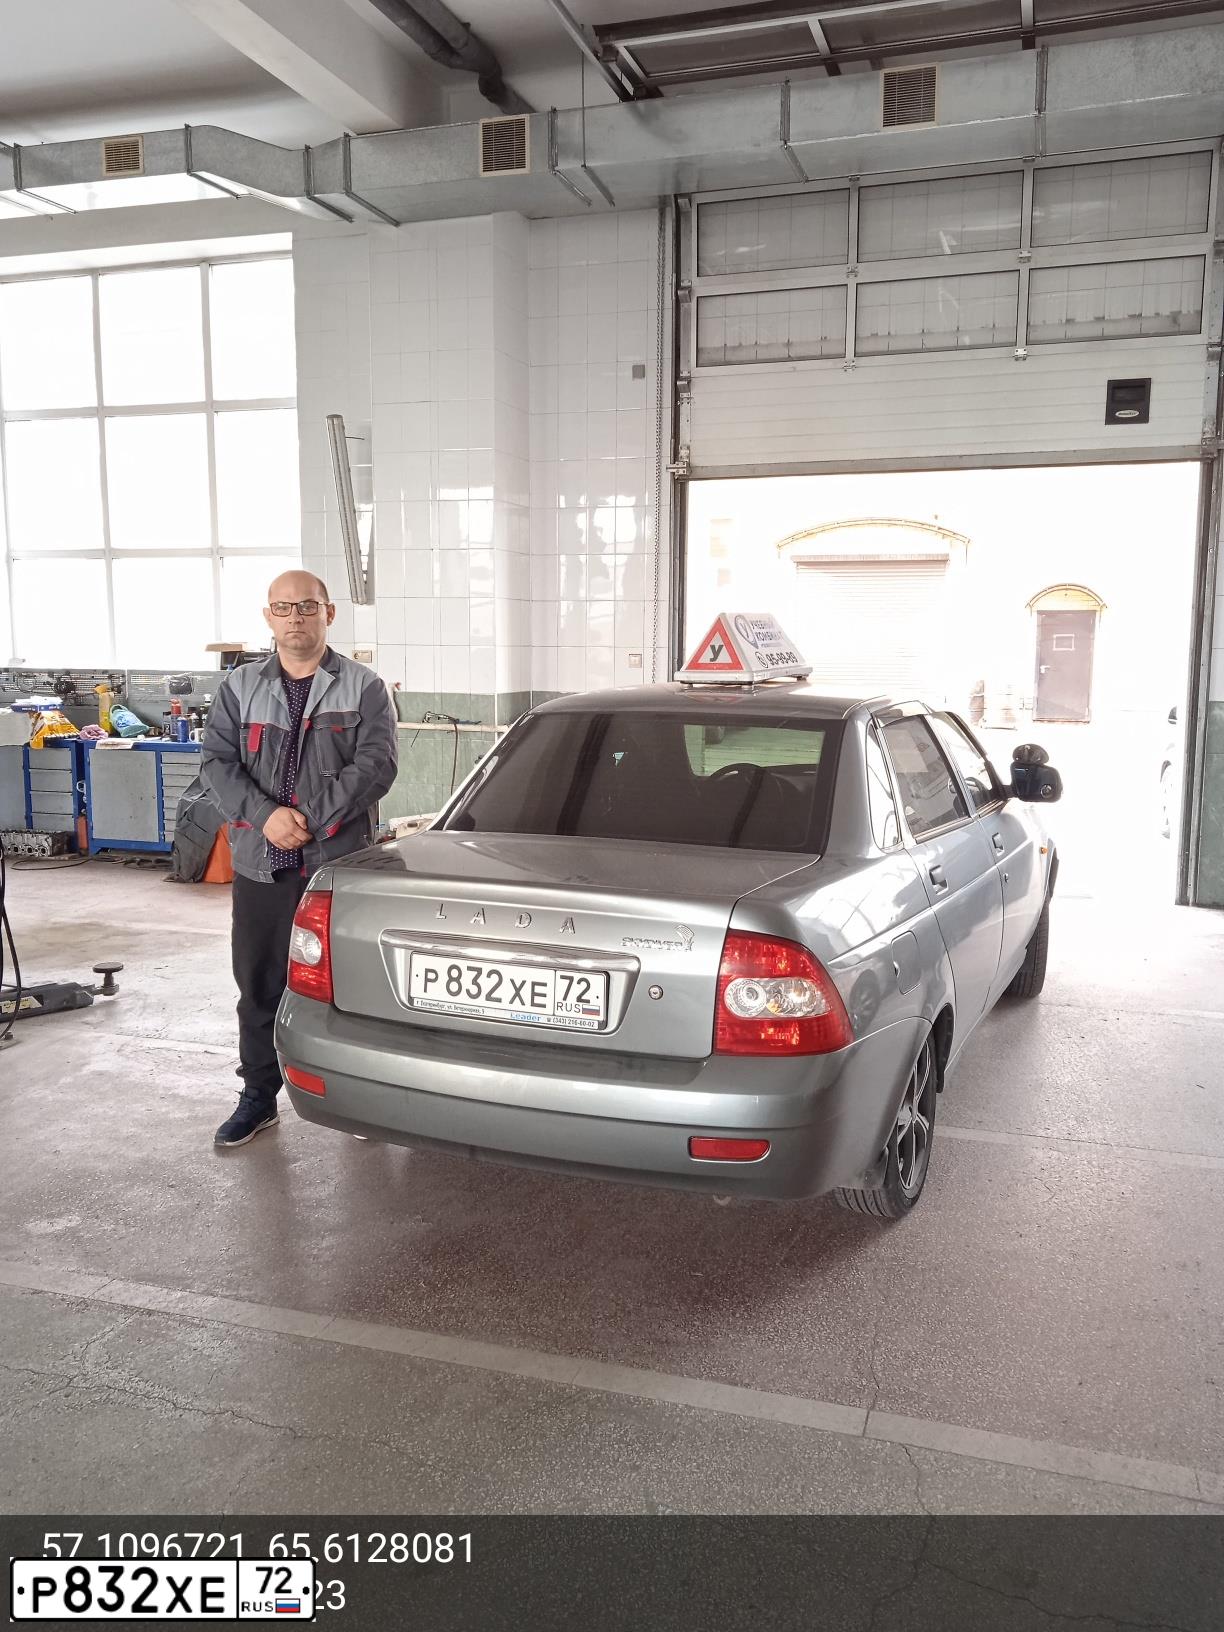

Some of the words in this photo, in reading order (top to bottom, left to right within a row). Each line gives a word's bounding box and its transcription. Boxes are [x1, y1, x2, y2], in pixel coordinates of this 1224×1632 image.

[709, 644, 724, 662] У
[435, 903, 576, 935] LADA
[559, 974, 592, 1004] 72
[556, 1001, 581, 1013] RUS
[510, 1012, 542, 1022] Leader
